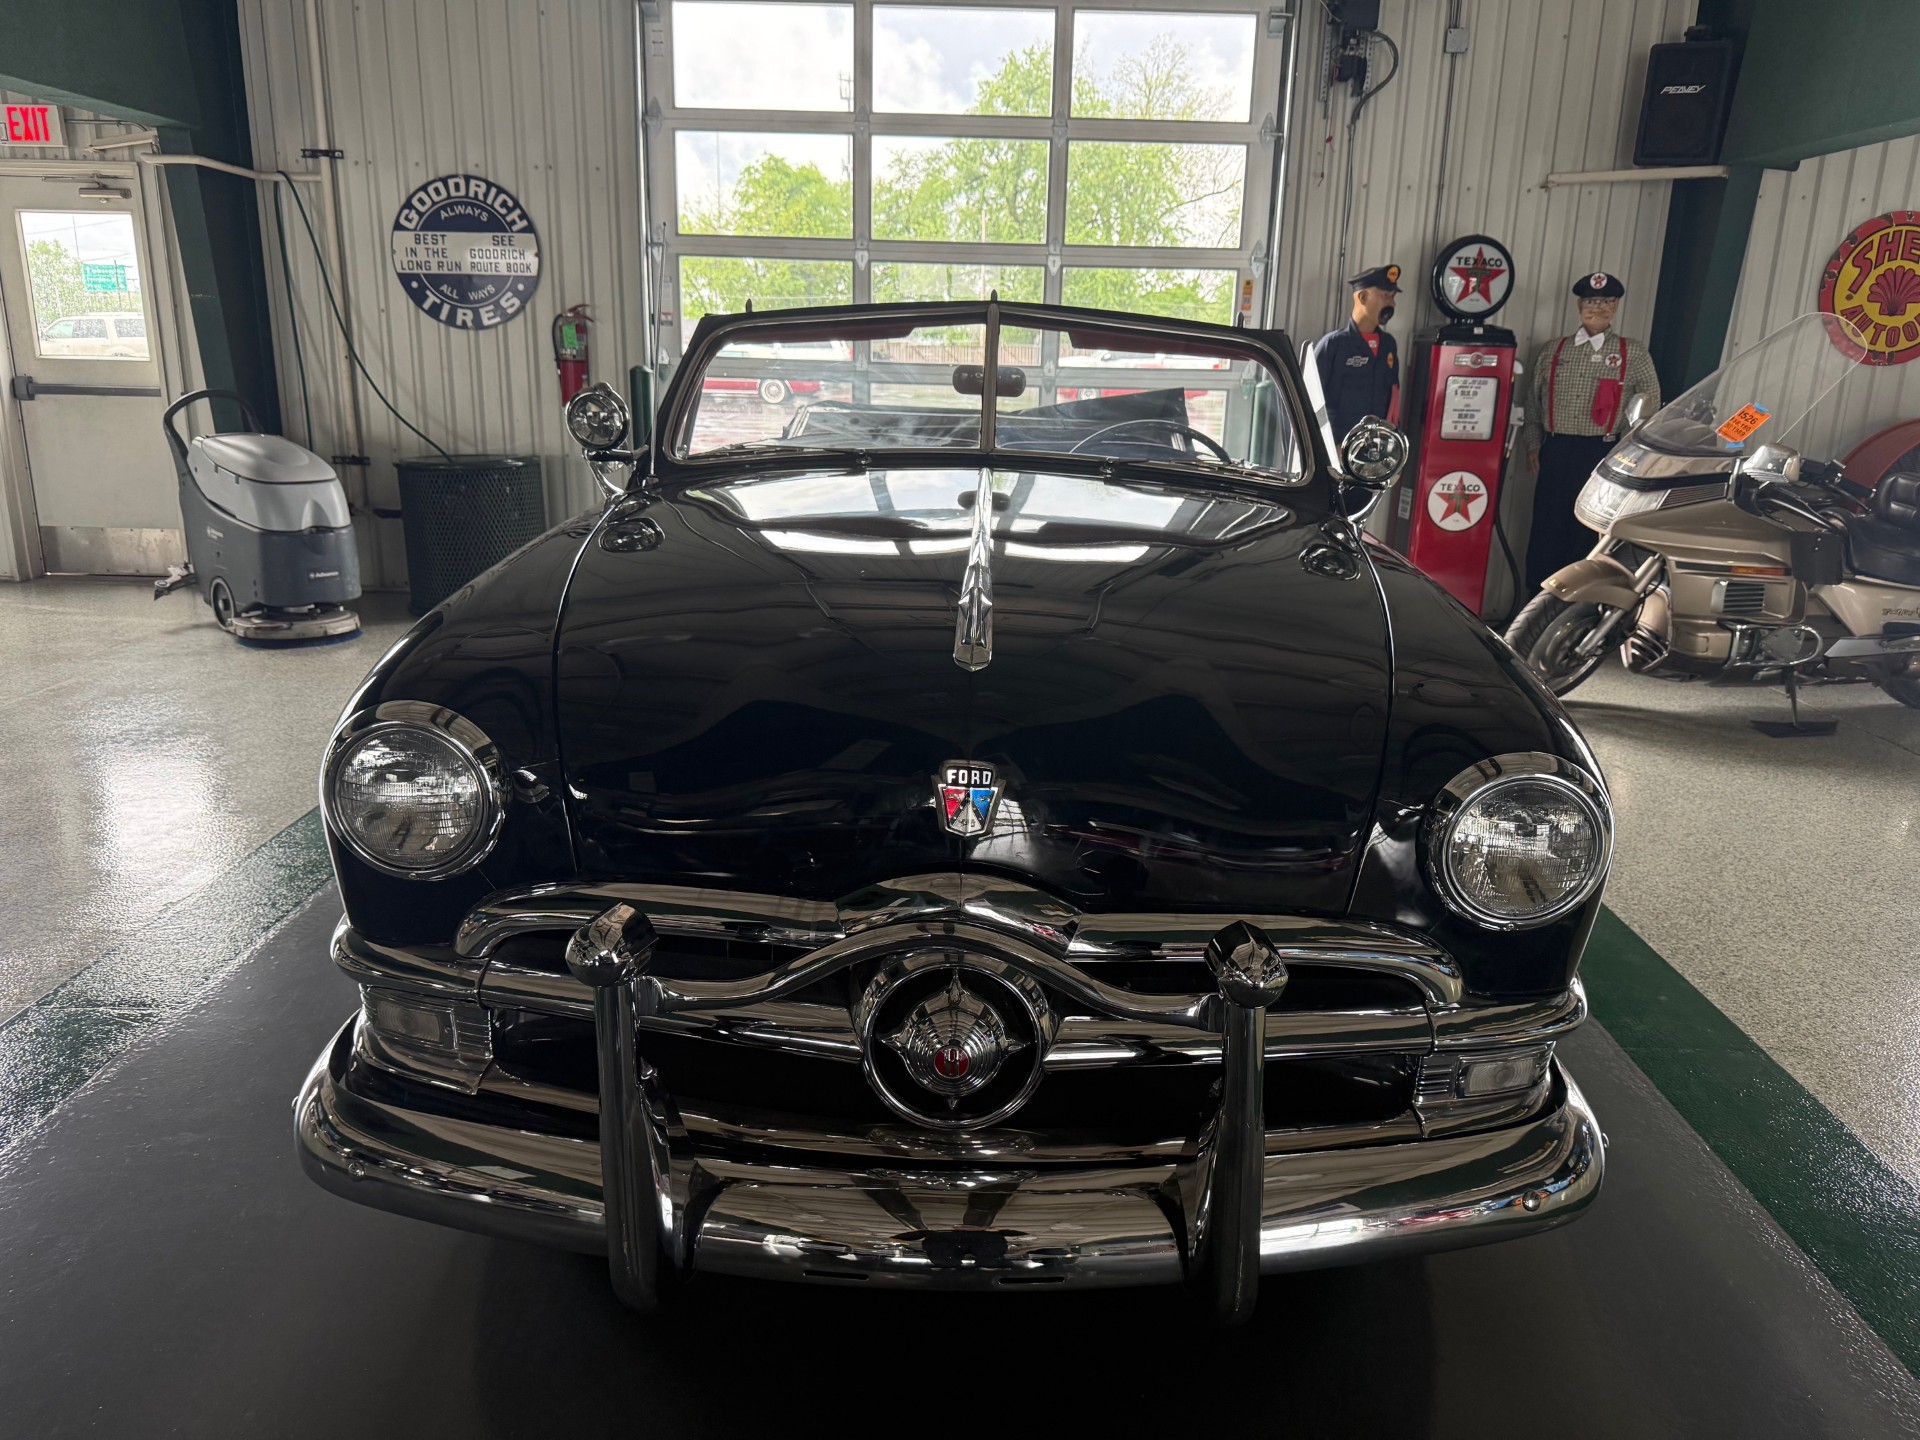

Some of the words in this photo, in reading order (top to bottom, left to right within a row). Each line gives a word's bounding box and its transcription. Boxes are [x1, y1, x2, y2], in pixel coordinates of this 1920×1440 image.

[1660, 84, 1706, 94] PEAVEY
[6, 106, 50, 142] EXIT
[398, 176, 529, 232] GOODRICH
[440, 204, 489, 222] ALWAYS
[414, 234, 447, 245] BEST
[492, 235, 515, 246] SEE
[405, 247, 418, 258] IN
[425, 247, 448, 258] THE
[469, 248, 525, 260] GOODRICH
[400, 260, 431, 271] LONG
[437, 260, 462, 271] RUN
[470, 261, 500, 273] ROUTE
[506, 262, 532, 274] BOOK
[1456, 256, 1503, 268] TEXACO
[439, 283, 459, 299] ALL
[468, 284, 496, 301] WAYS
[422, 289, 521, 328] TIRES
[1840, 304, 1920, 348] AUTOO
[1738, 410, 1759, 425] 1526
[1440, 483, 1481, 492] TEXACO
[946, 769, 992, 785] FORD
